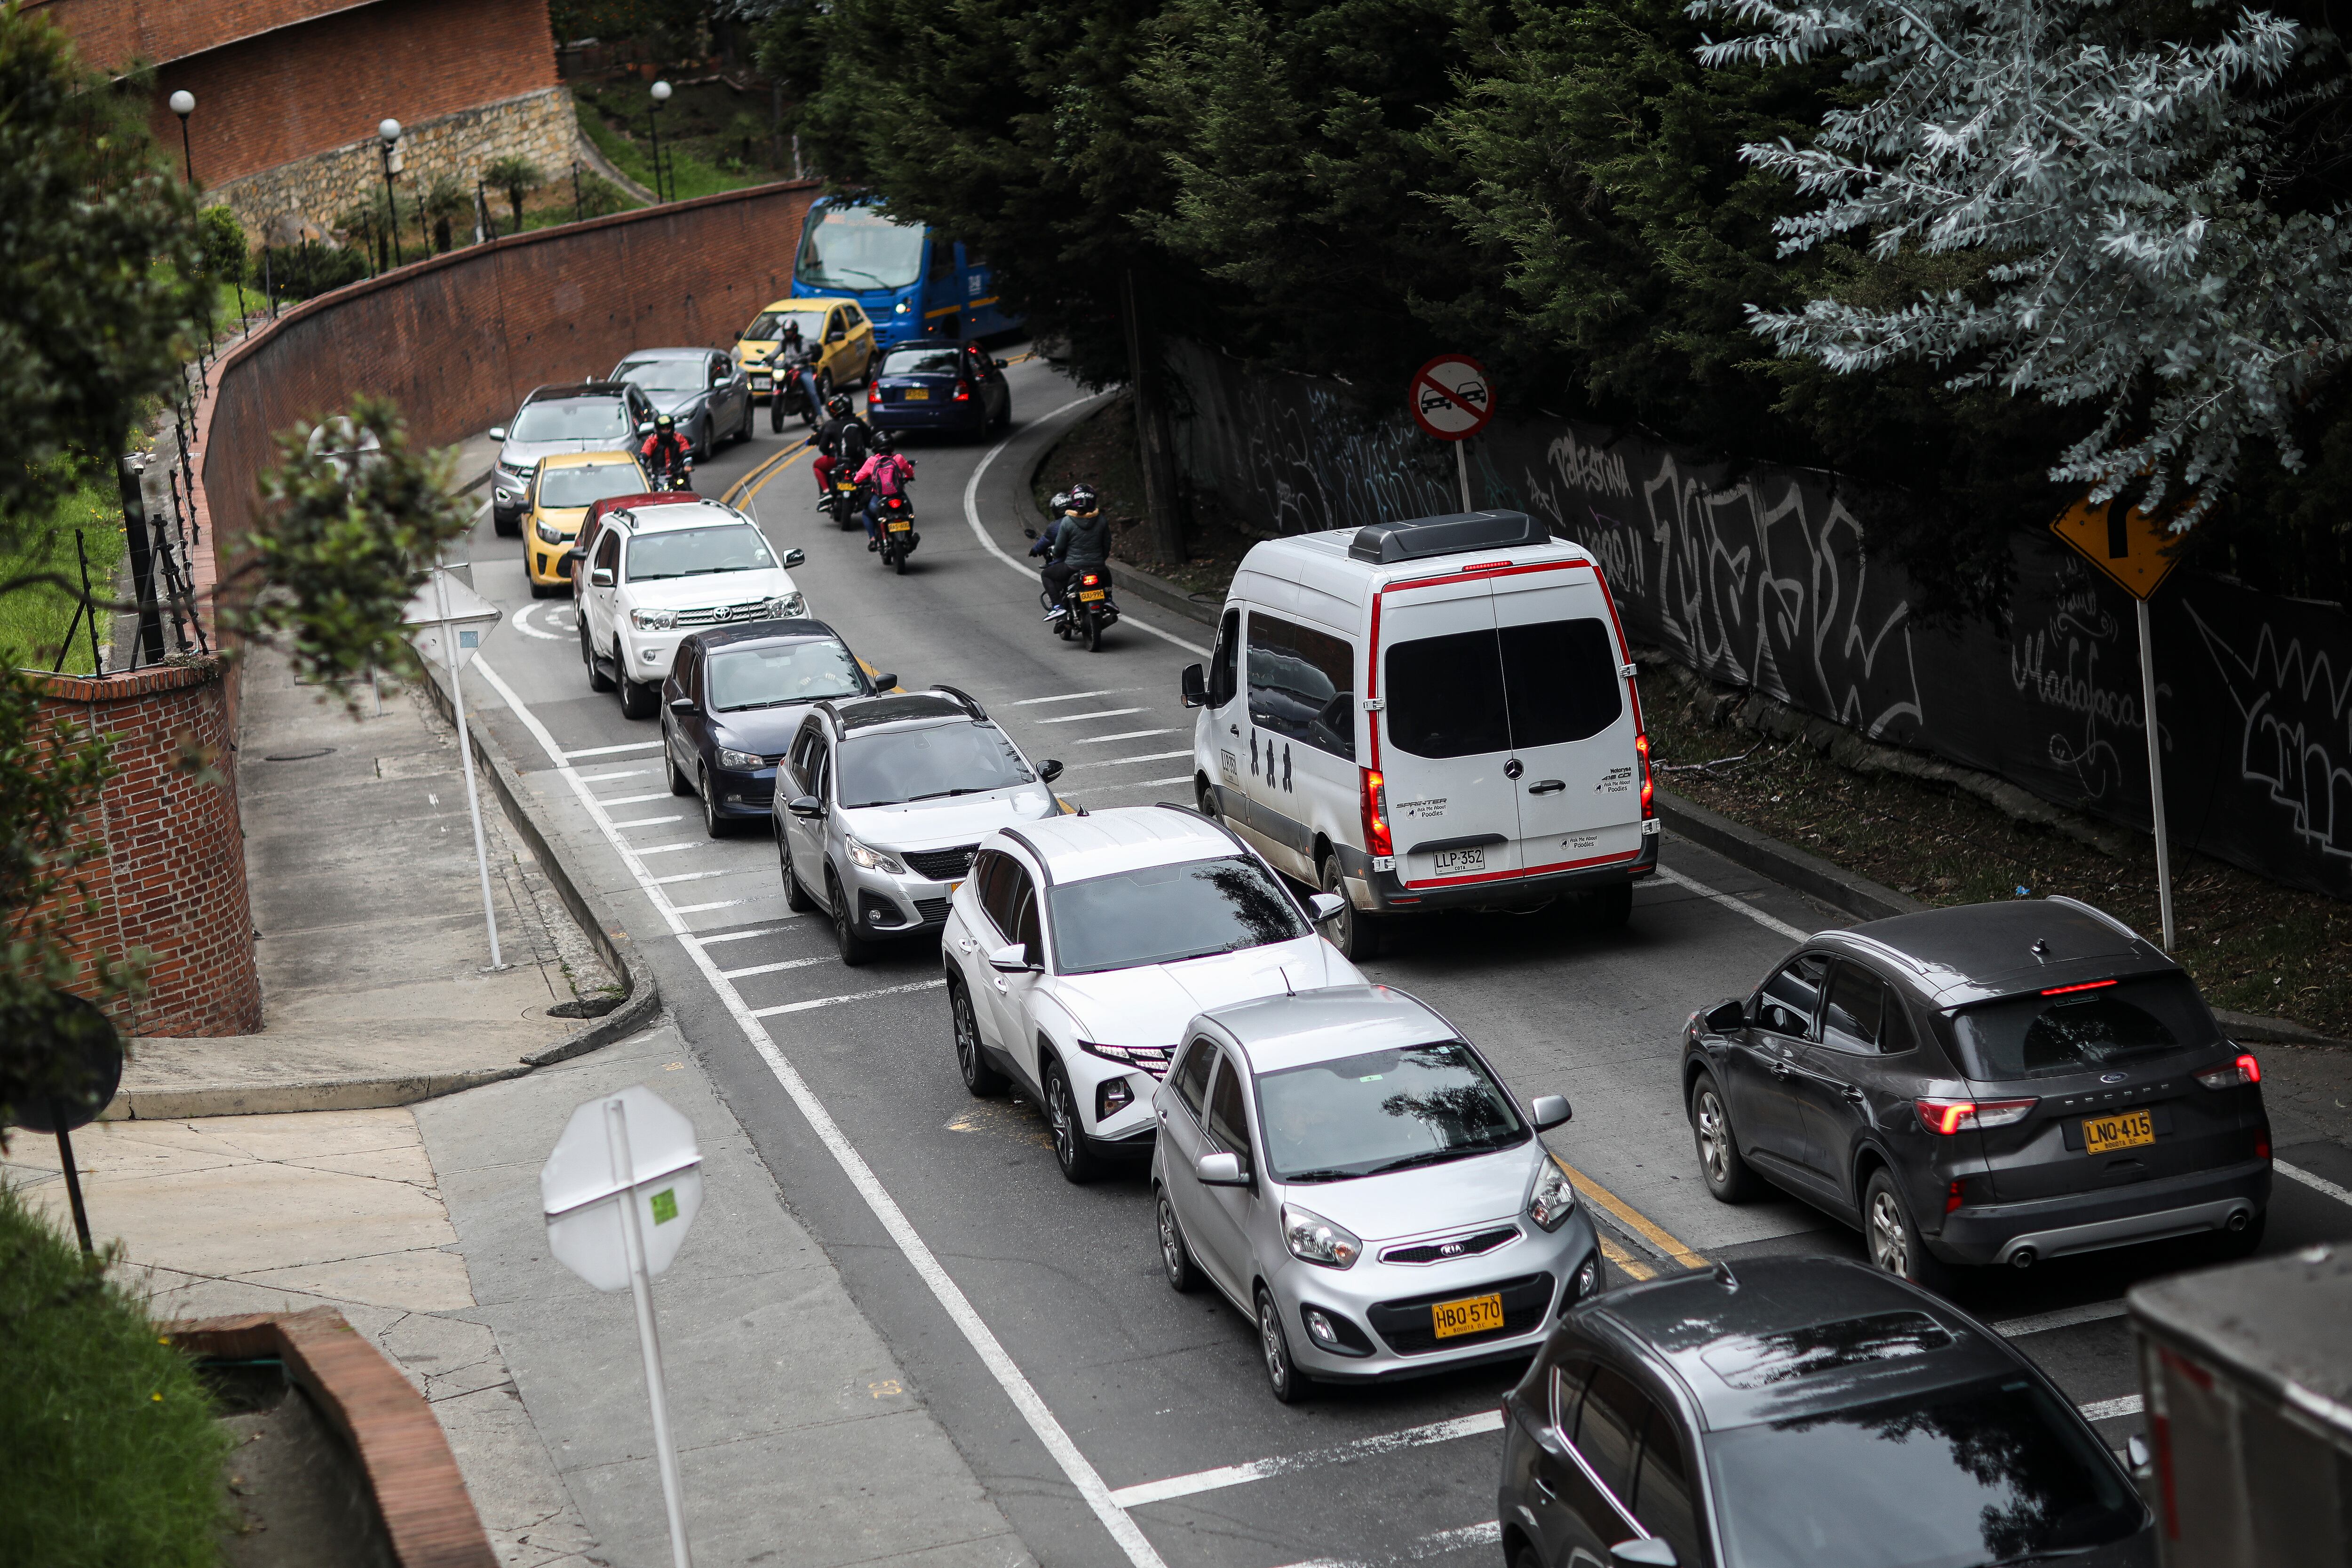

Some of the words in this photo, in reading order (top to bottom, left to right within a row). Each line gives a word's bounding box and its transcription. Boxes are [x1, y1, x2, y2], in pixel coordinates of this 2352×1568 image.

[1396, 798, 1447, 808] SPRINTER
[2065, 1084, 2169, 1105] ESCAPE
[1445, 1244, 1462, 1255] KIA
